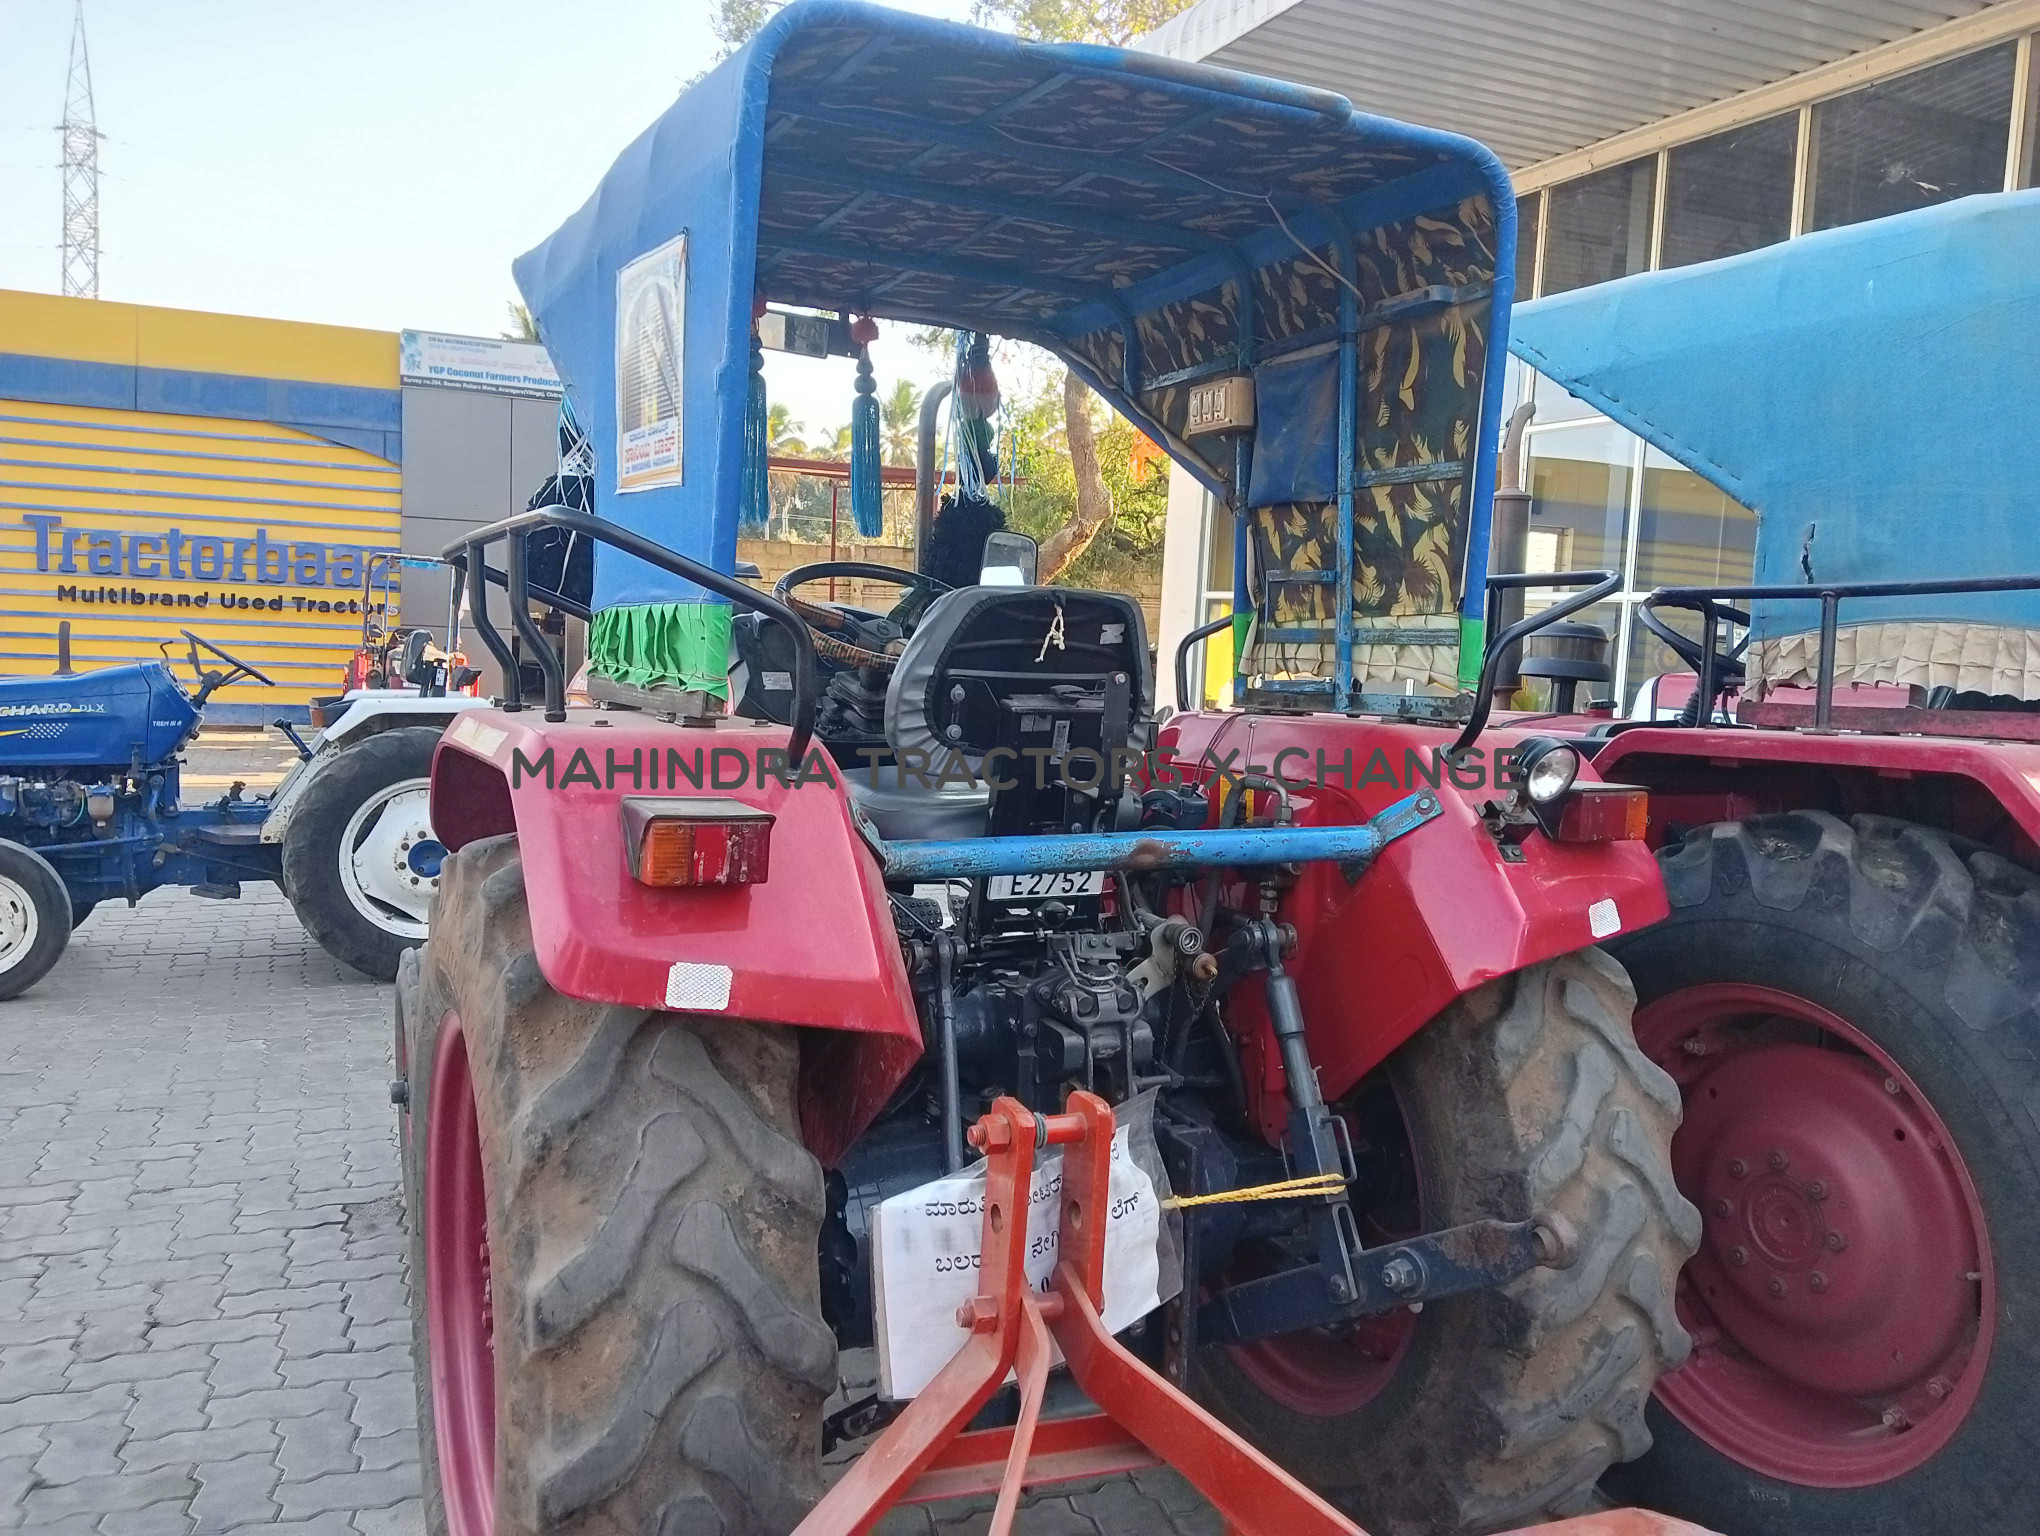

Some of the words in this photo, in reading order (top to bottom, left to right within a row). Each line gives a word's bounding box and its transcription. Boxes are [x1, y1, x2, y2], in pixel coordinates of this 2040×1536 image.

[428, 365, 446, 375] YGP
[447, 367, 484, 379] Coconut
[486, 371, 522, 383] Farmers
[23, 514, 399, 589] Tractorbaaz
[57, 584, 209, 609] Multibrand
[220, 592, 283, 612] Used
[292, 596, 400, 617] Tractors
[79, 703, 105, 712] DLX
